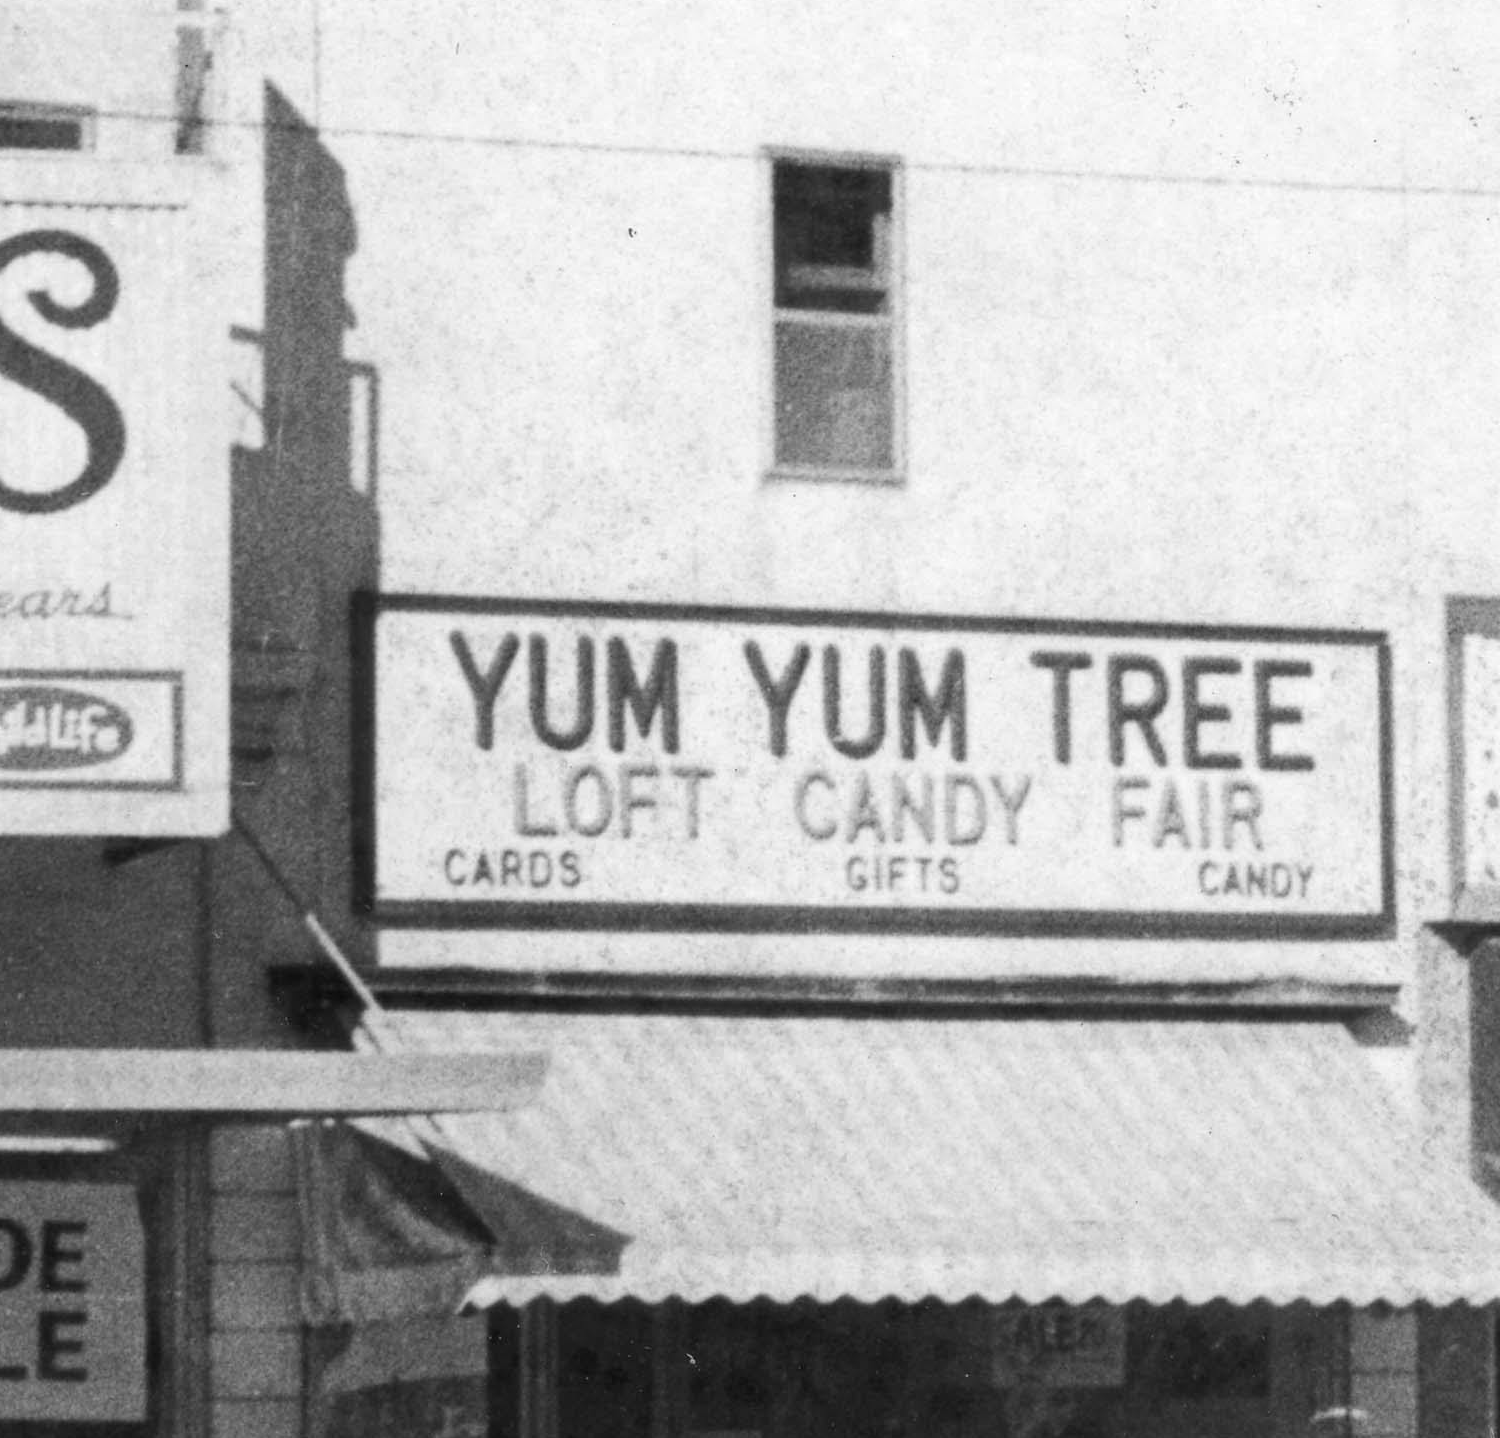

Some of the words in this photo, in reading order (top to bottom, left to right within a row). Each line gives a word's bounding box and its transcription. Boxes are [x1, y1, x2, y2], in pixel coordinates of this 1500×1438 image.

[450, 629, 679, 753] YUM
[744, 638, 967, 762] YUM
[1031, 650, 1314, 772] TREE
[515, 764, 712, 839] LOFT
[794, 770, 1031, 848] CANDY
[1112, 777, 1263, 850] FAIR
[443, 848, 581, 890] CARDS
[845, 854, 961, 895] GIFTS
[1197, 859, 1314, 899] CANDY
